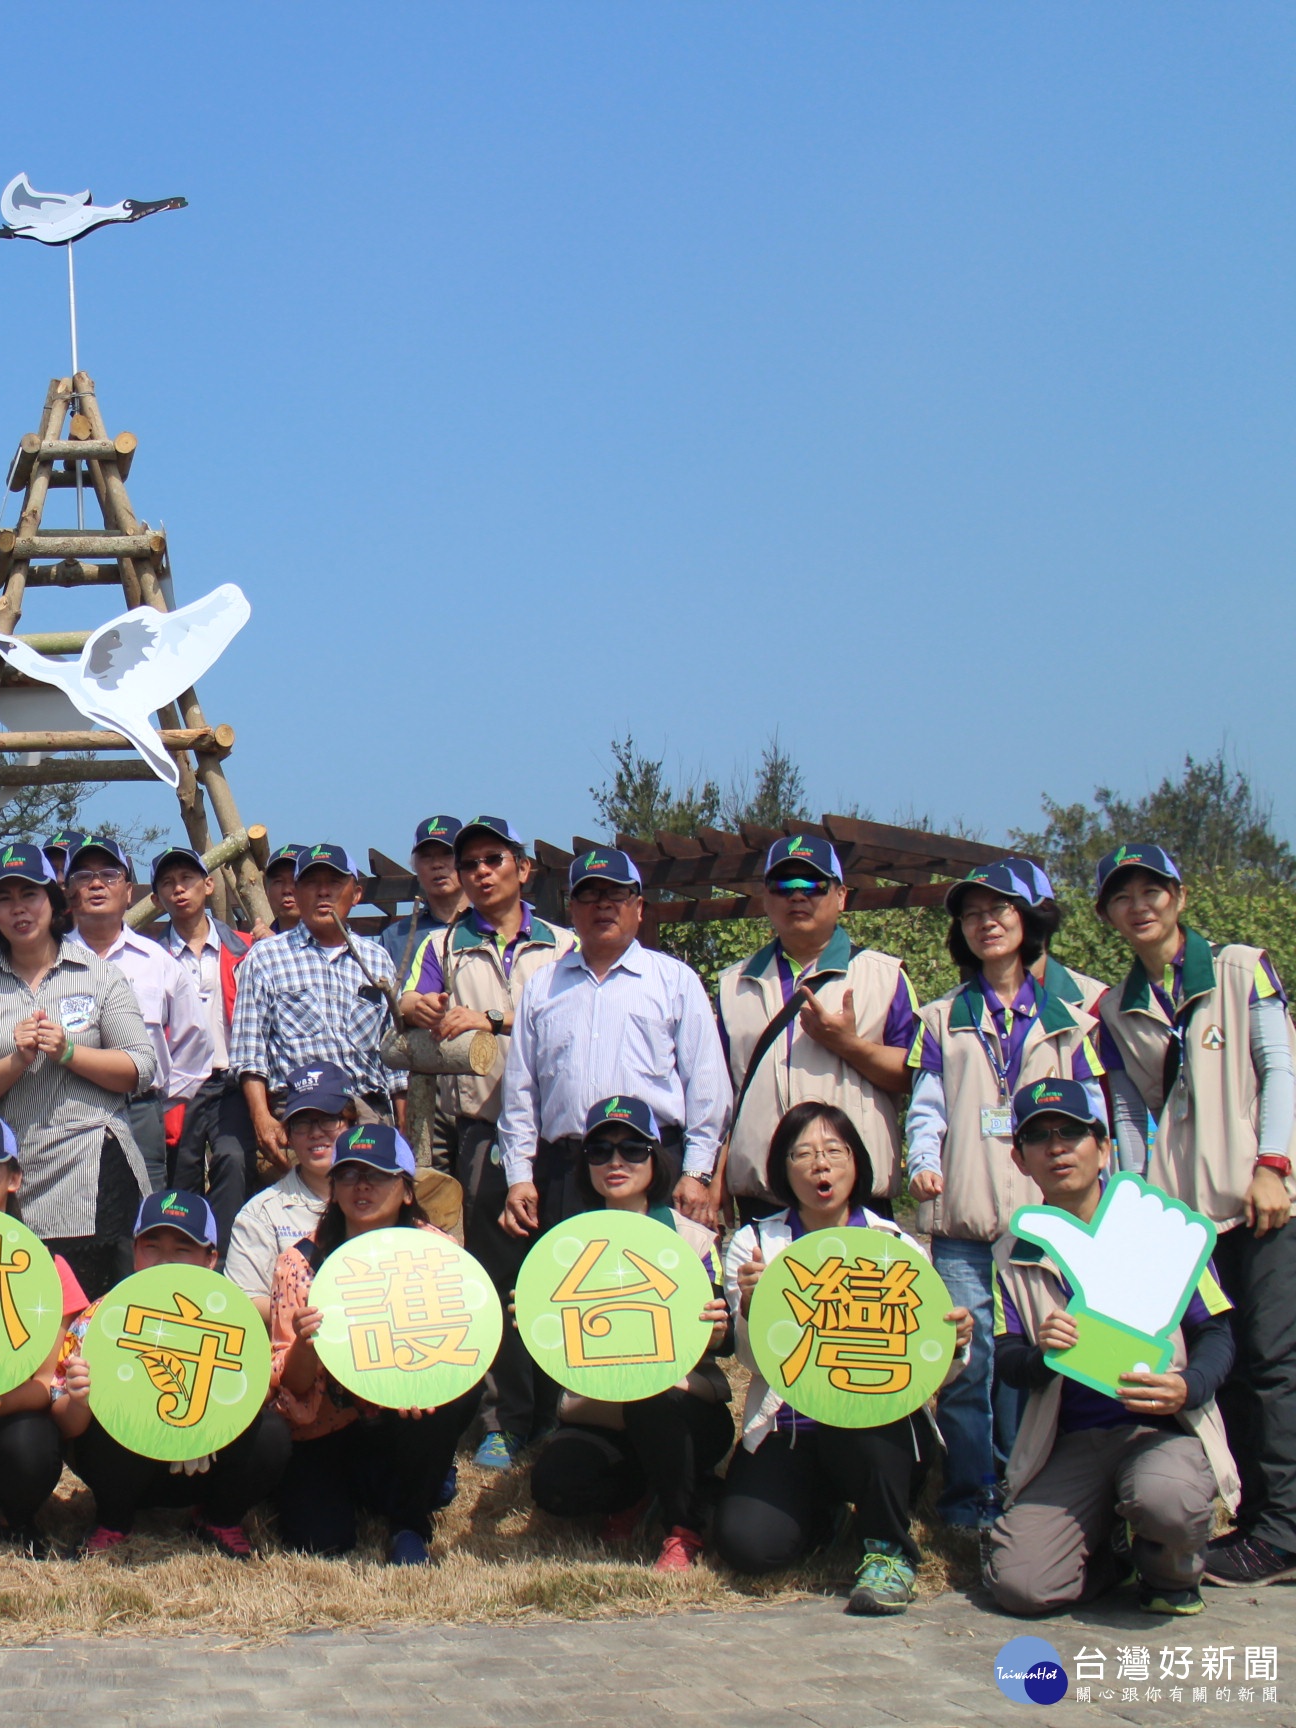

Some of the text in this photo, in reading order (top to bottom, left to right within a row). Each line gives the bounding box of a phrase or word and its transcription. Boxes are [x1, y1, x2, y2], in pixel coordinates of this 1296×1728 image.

[116, 1292, 245, 1429] 守
[336, 1246, 479, 1373] 護
[553, 1240, 676, 1368] 台
[781, 1257, 922, 1395] 灣
